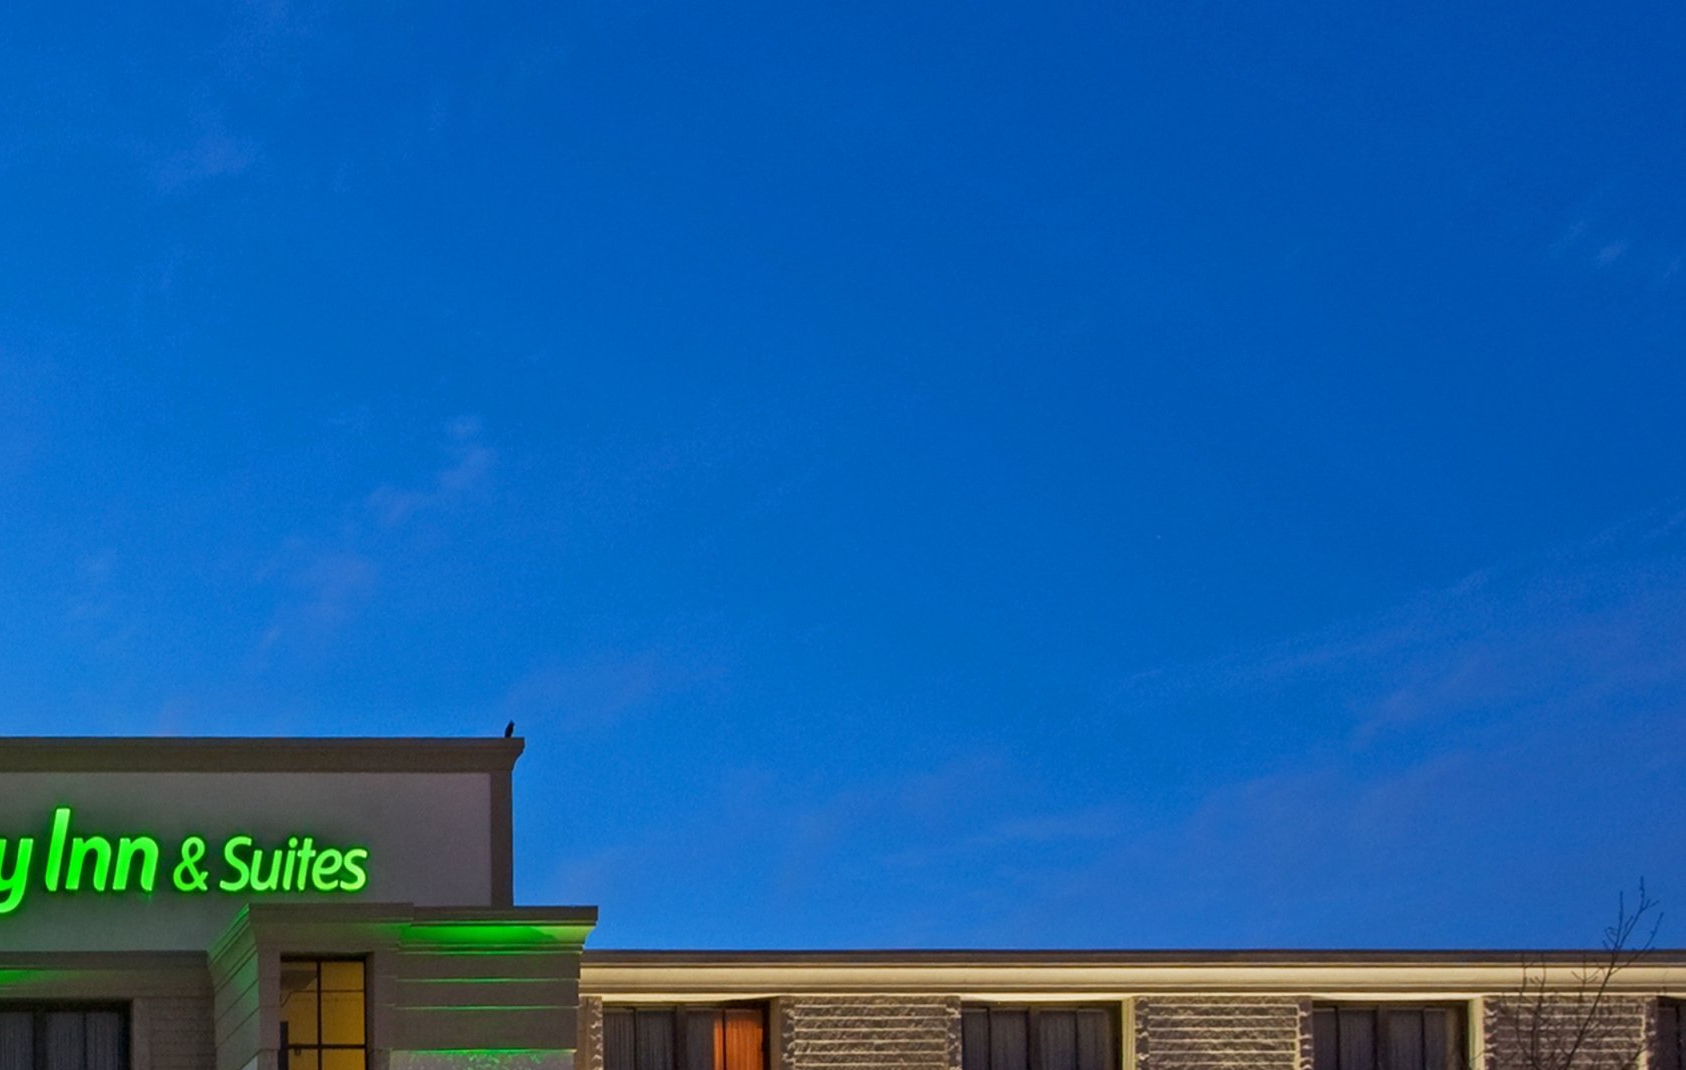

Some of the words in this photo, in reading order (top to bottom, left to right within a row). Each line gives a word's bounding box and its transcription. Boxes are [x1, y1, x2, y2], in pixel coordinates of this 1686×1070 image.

[44, 807, 159, 892] Inn
[173, 836, 209, 892] &
[219, 835, 368, 892] Suites
